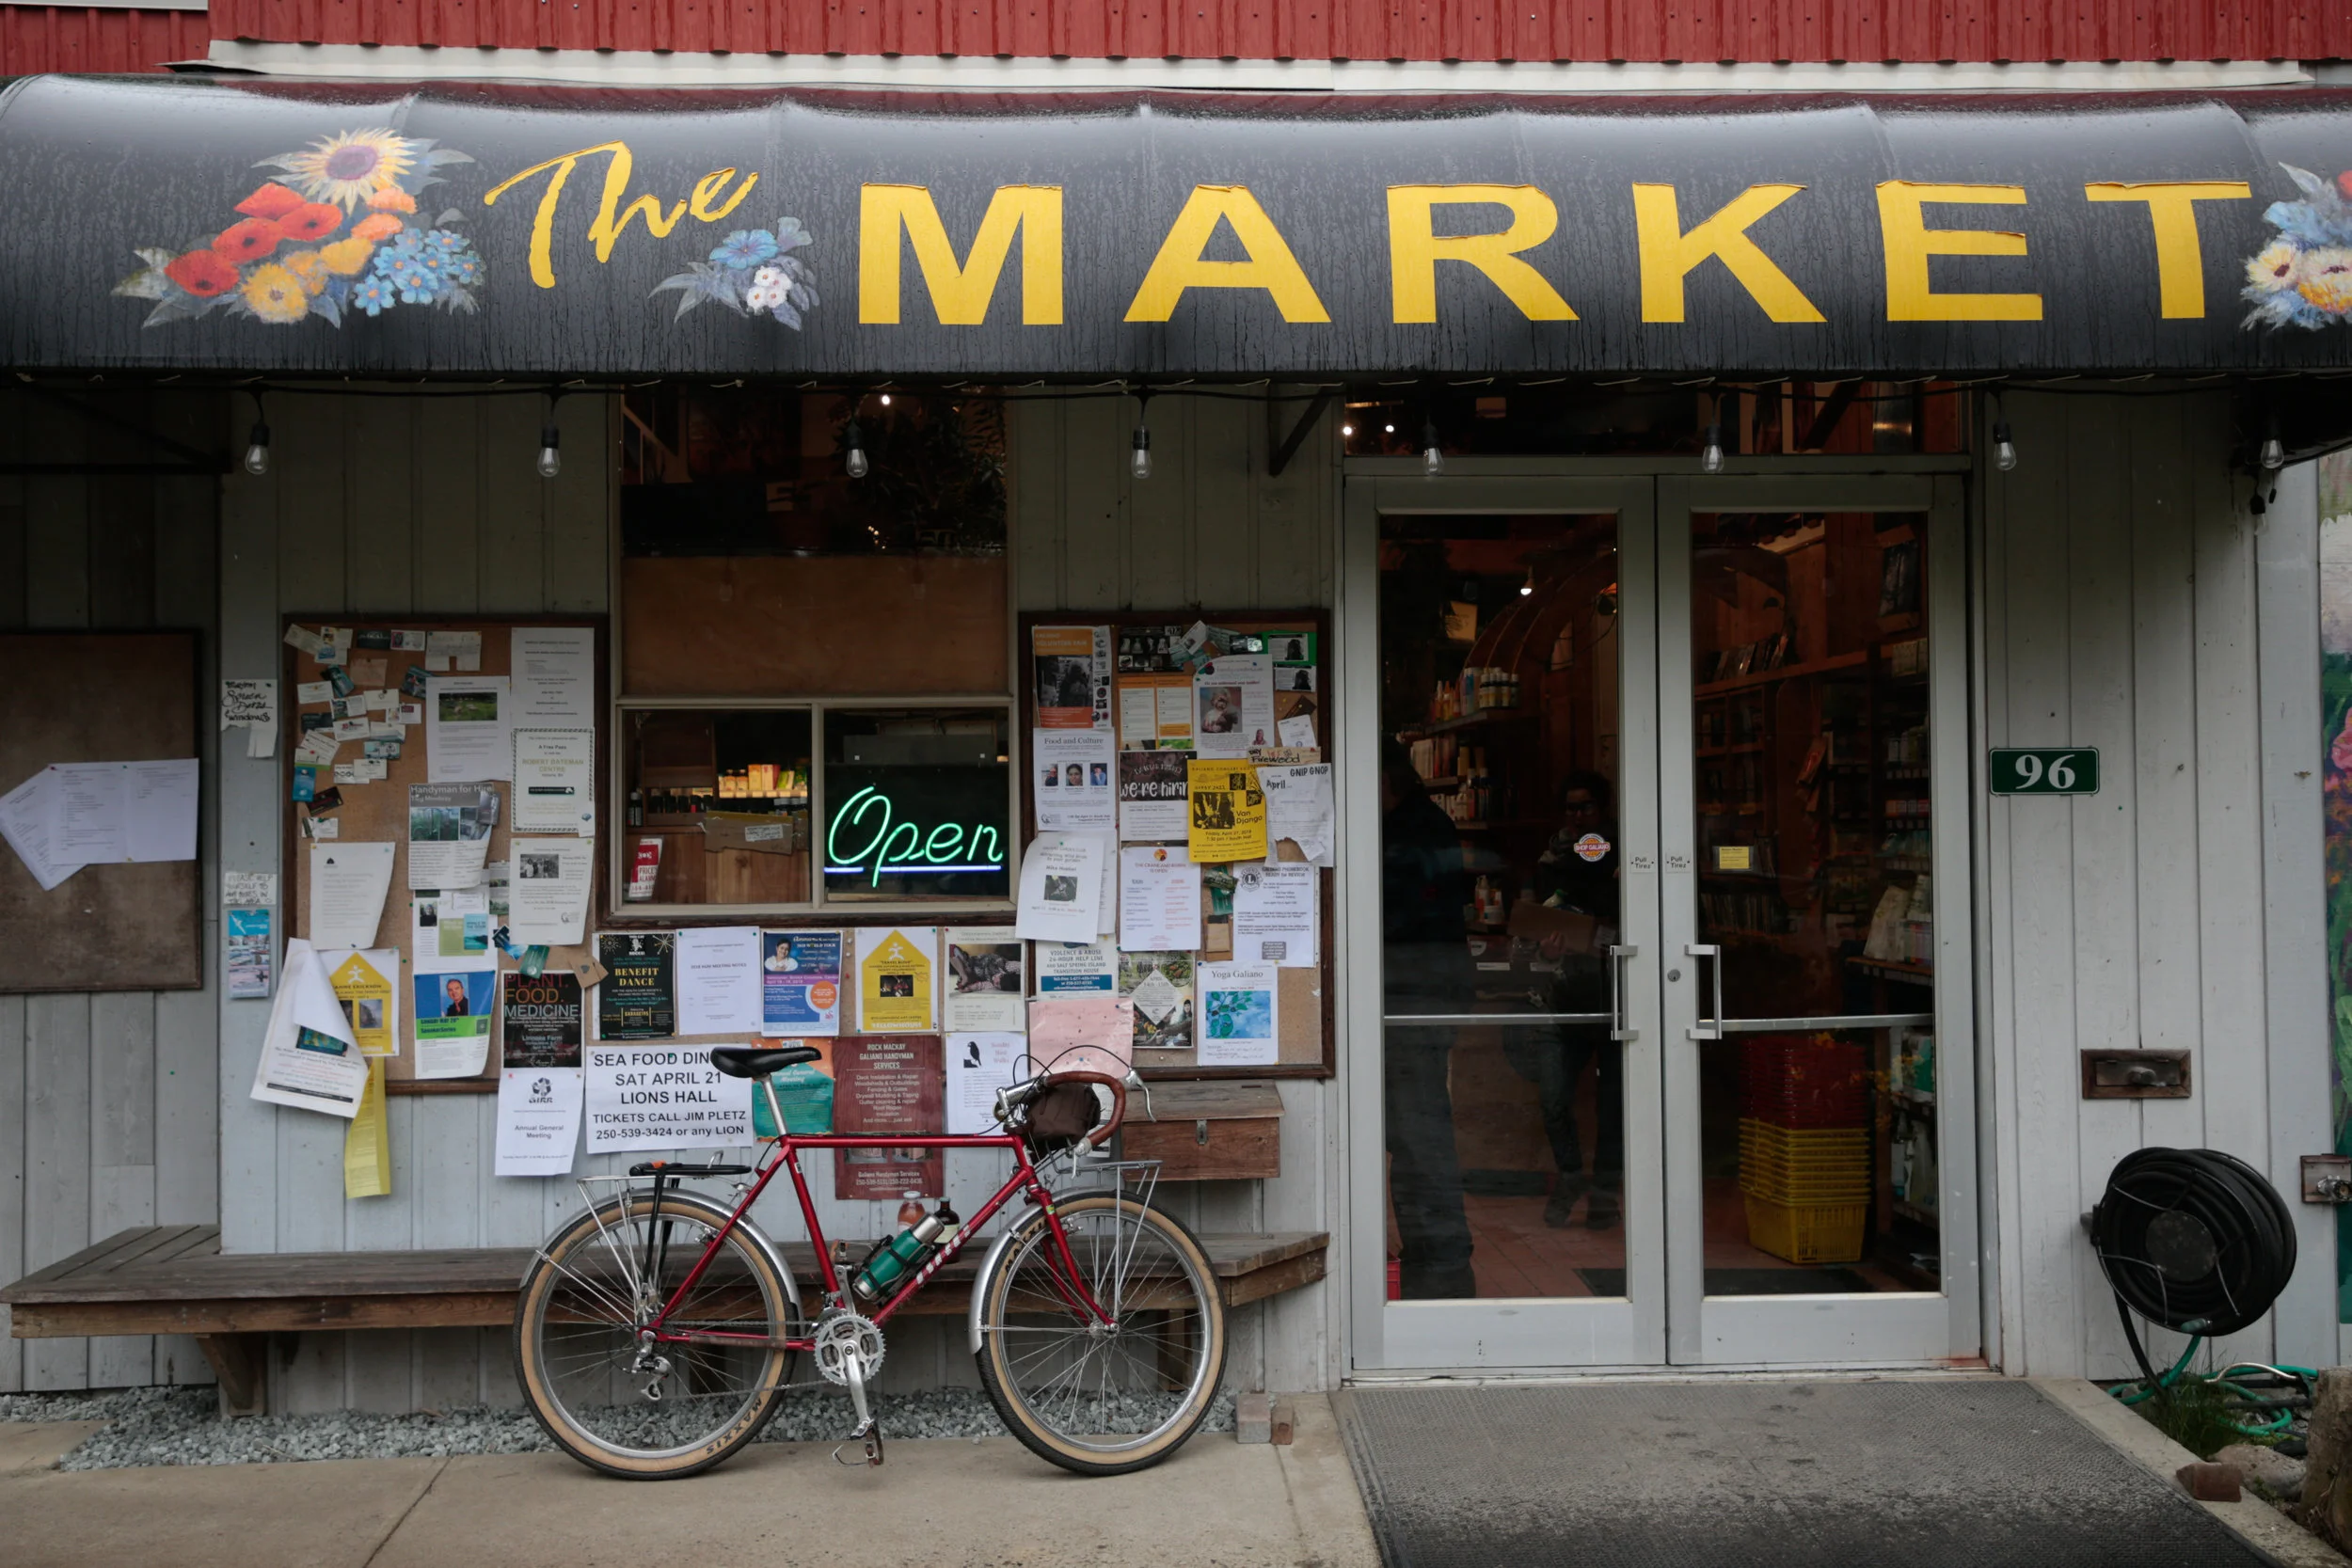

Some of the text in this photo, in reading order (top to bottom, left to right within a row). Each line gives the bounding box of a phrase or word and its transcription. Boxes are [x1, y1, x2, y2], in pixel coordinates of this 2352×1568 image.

[484, 140, 2252, 325] The MARKET
[1251, 752, 1300, 764] Firewood
[1290, 766, 1328, 777] GNIP GNOP
[2015, 754, 2075, 790] 96
[411, 785, 458, 795] Handyman
[1161, 782, 1188, 797] hirin
[1266, 780, 1286, 790] April
[1236, 816, 1263, 825] Django
[829, 786, 1004, 888] Open
[614, 968, 660, 976] BENEFIT
[1211, 970, 1263, 979] Yoga Galiano
[619, 977, 655, 986] DANCE
[504, 988, 564, 1004] FOOD.
[504, 1005, 581, 1017] MEDICINE.
[594, 1052, 709, 1067] SEA FOOD DIN
[615, 1071, 722, 1086] SAT APRIL 21
[621, 1090, 717, 1104] LIONS HALL
[593, 1111, 746, 1124] TICKETS CALL JIM PLETZ
[596, 1128, 673, 1139] 250-539-3424
[691, 1128, 711, 1137] any
[716, 1126, 744, 1135] LION
[706, 1398, 763, 1456] MAXXIS
